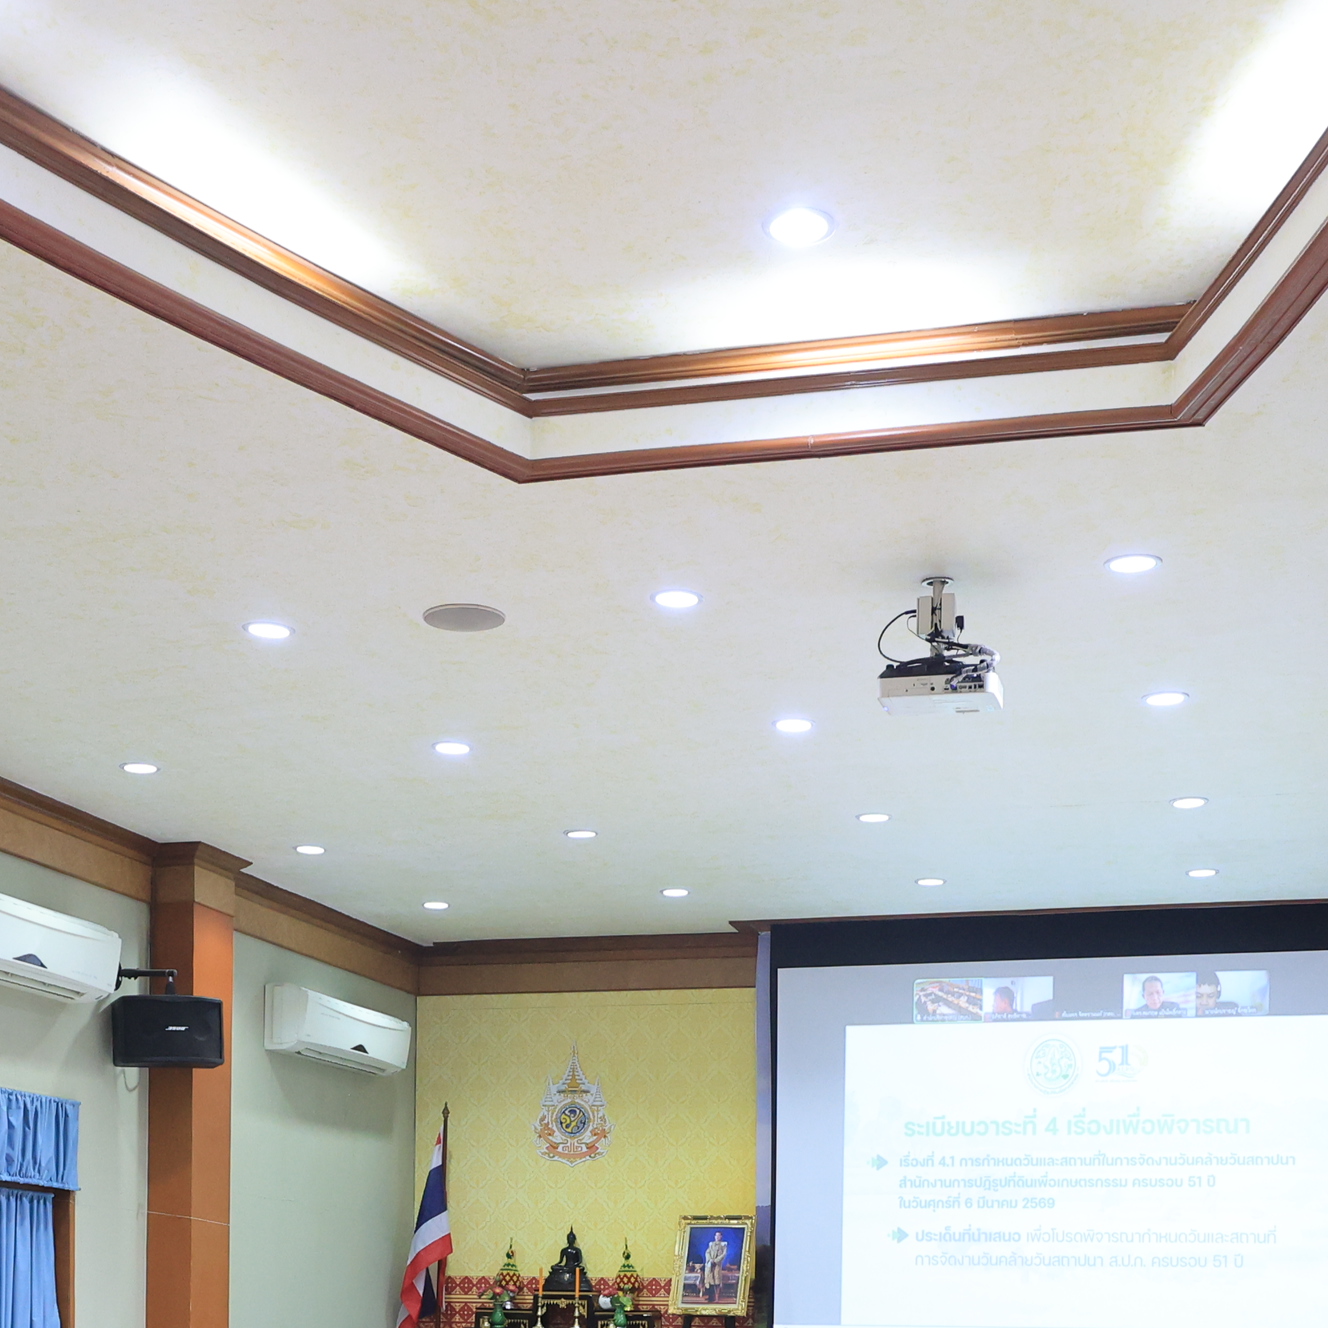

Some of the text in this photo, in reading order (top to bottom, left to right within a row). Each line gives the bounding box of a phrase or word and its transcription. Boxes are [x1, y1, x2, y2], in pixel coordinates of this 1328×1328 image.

[1096, 1044, 1131, 1077] 51
[904, 1106, 1251, 1137] ระเบียบวาระที่ 4 เรื่องเพื่อพิจารณา
[899, 1151, 935, 1167] เรื่องที่
[938, 1156, 955, 1167] 4.1
[1132, 1176, 1184, 1188] ครบรอบ
[1188, 1176, 1202, 1188] 51
[1207, 1174, 1216, 1188] ปี
[899, 1193, 1055, 1212] ในวันศุกร์ที่ 6 มีนาคม 2569
[915, 1225, 1021, 1243] ประเด็นที่นำเสนอ
[915, 1250, 1244, 1269] การจัดงานวันคล้ายวันสถาปนา ส.ป.ก. ครบรอบ 51 ปี
